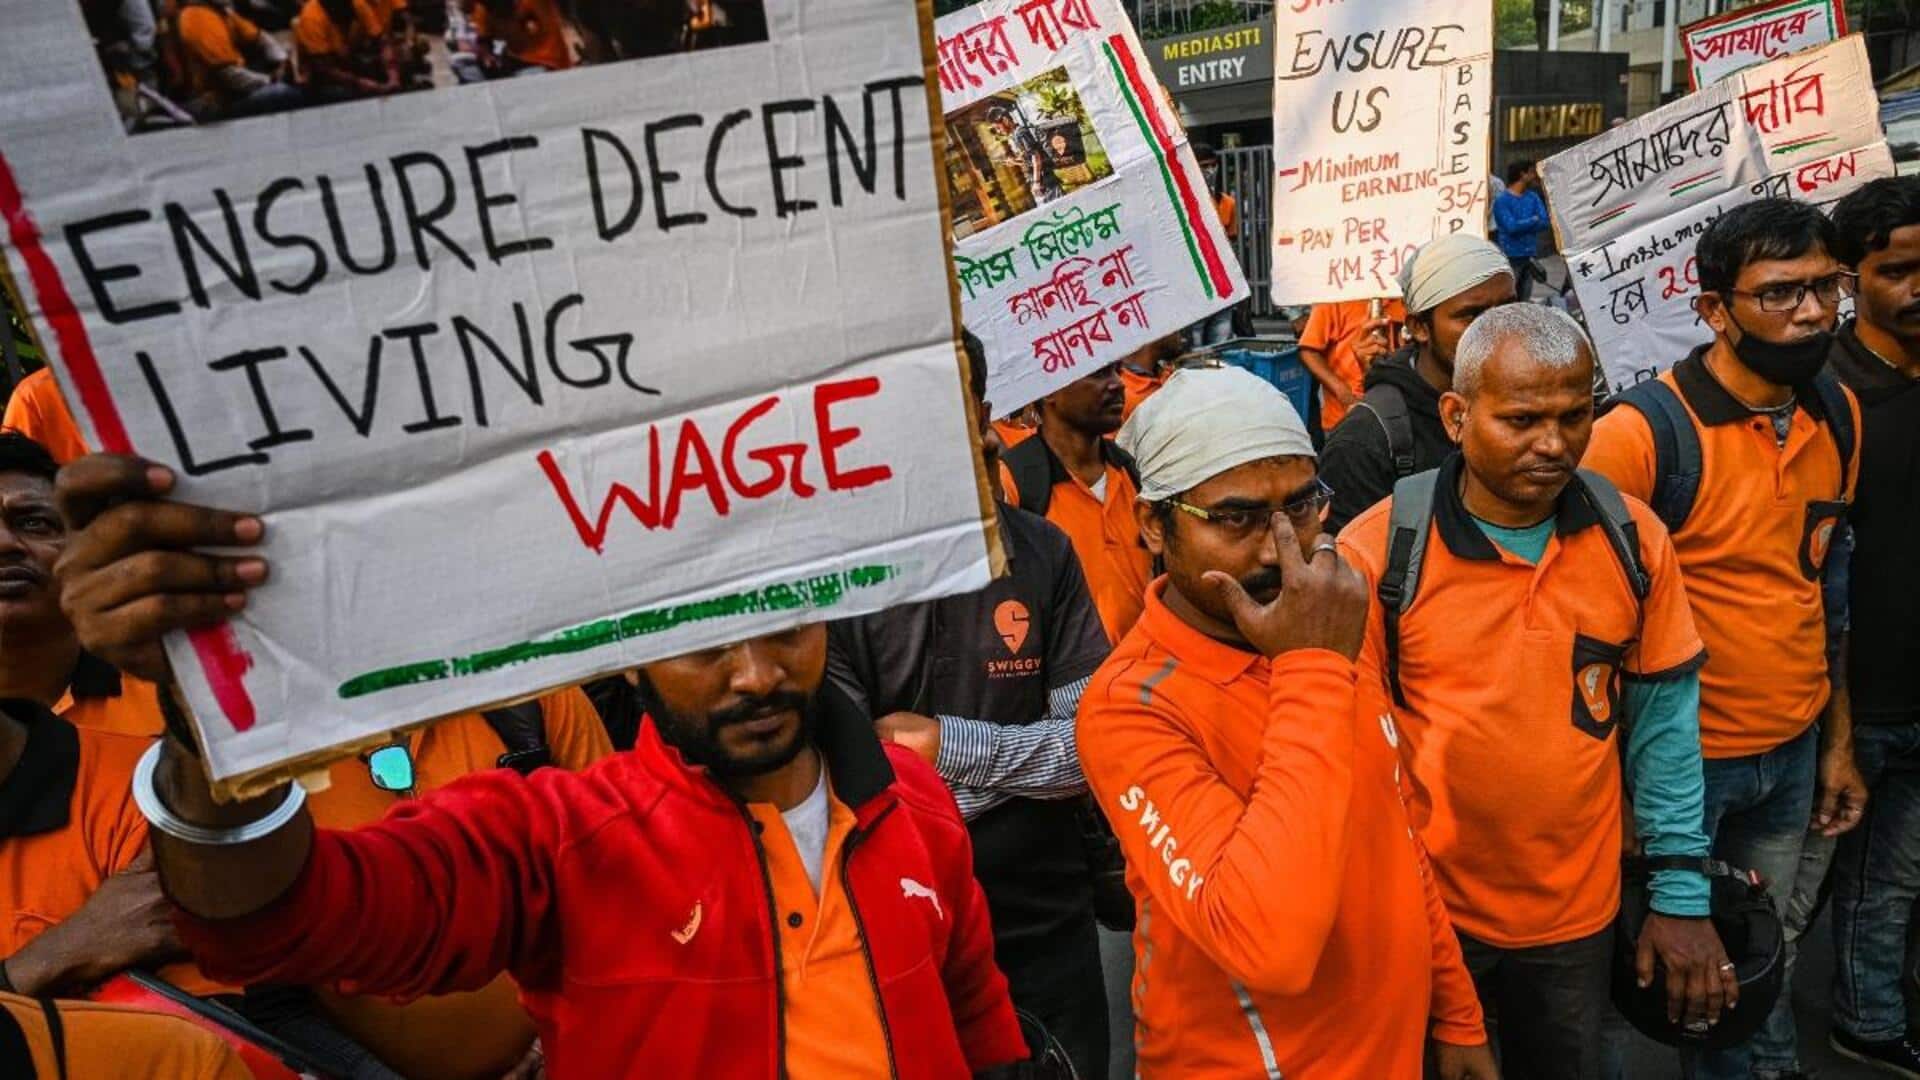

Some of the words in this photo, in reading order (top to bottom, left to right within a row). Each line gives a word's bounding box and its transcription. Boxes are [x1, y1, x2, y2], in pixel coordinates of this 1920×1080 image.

[1163, 27, 1262, 60] MEDIASITI
[1279, 24, 1465, 81] ENSURE
[1178, 55, 1247, 86] ENTRY
[1331, 85, 1391, 134] US
[66, 135, 555, 325] ENSURE
[581, 75, 926, 243] DECENT
[1341, 168, 1439, 204] EARNING
[1300, 227, 1334, 254] PAY
[1342, 216, 1390, 246] PER
[1327, 255, 1365, 291] KM
[136, 292, 663, 478] LIVING
[537, 376, 893, 556] WAGE
[987, 657, 1041, 673] SWIGGY
[1119, 784, 1204, 900] SWIGGY
